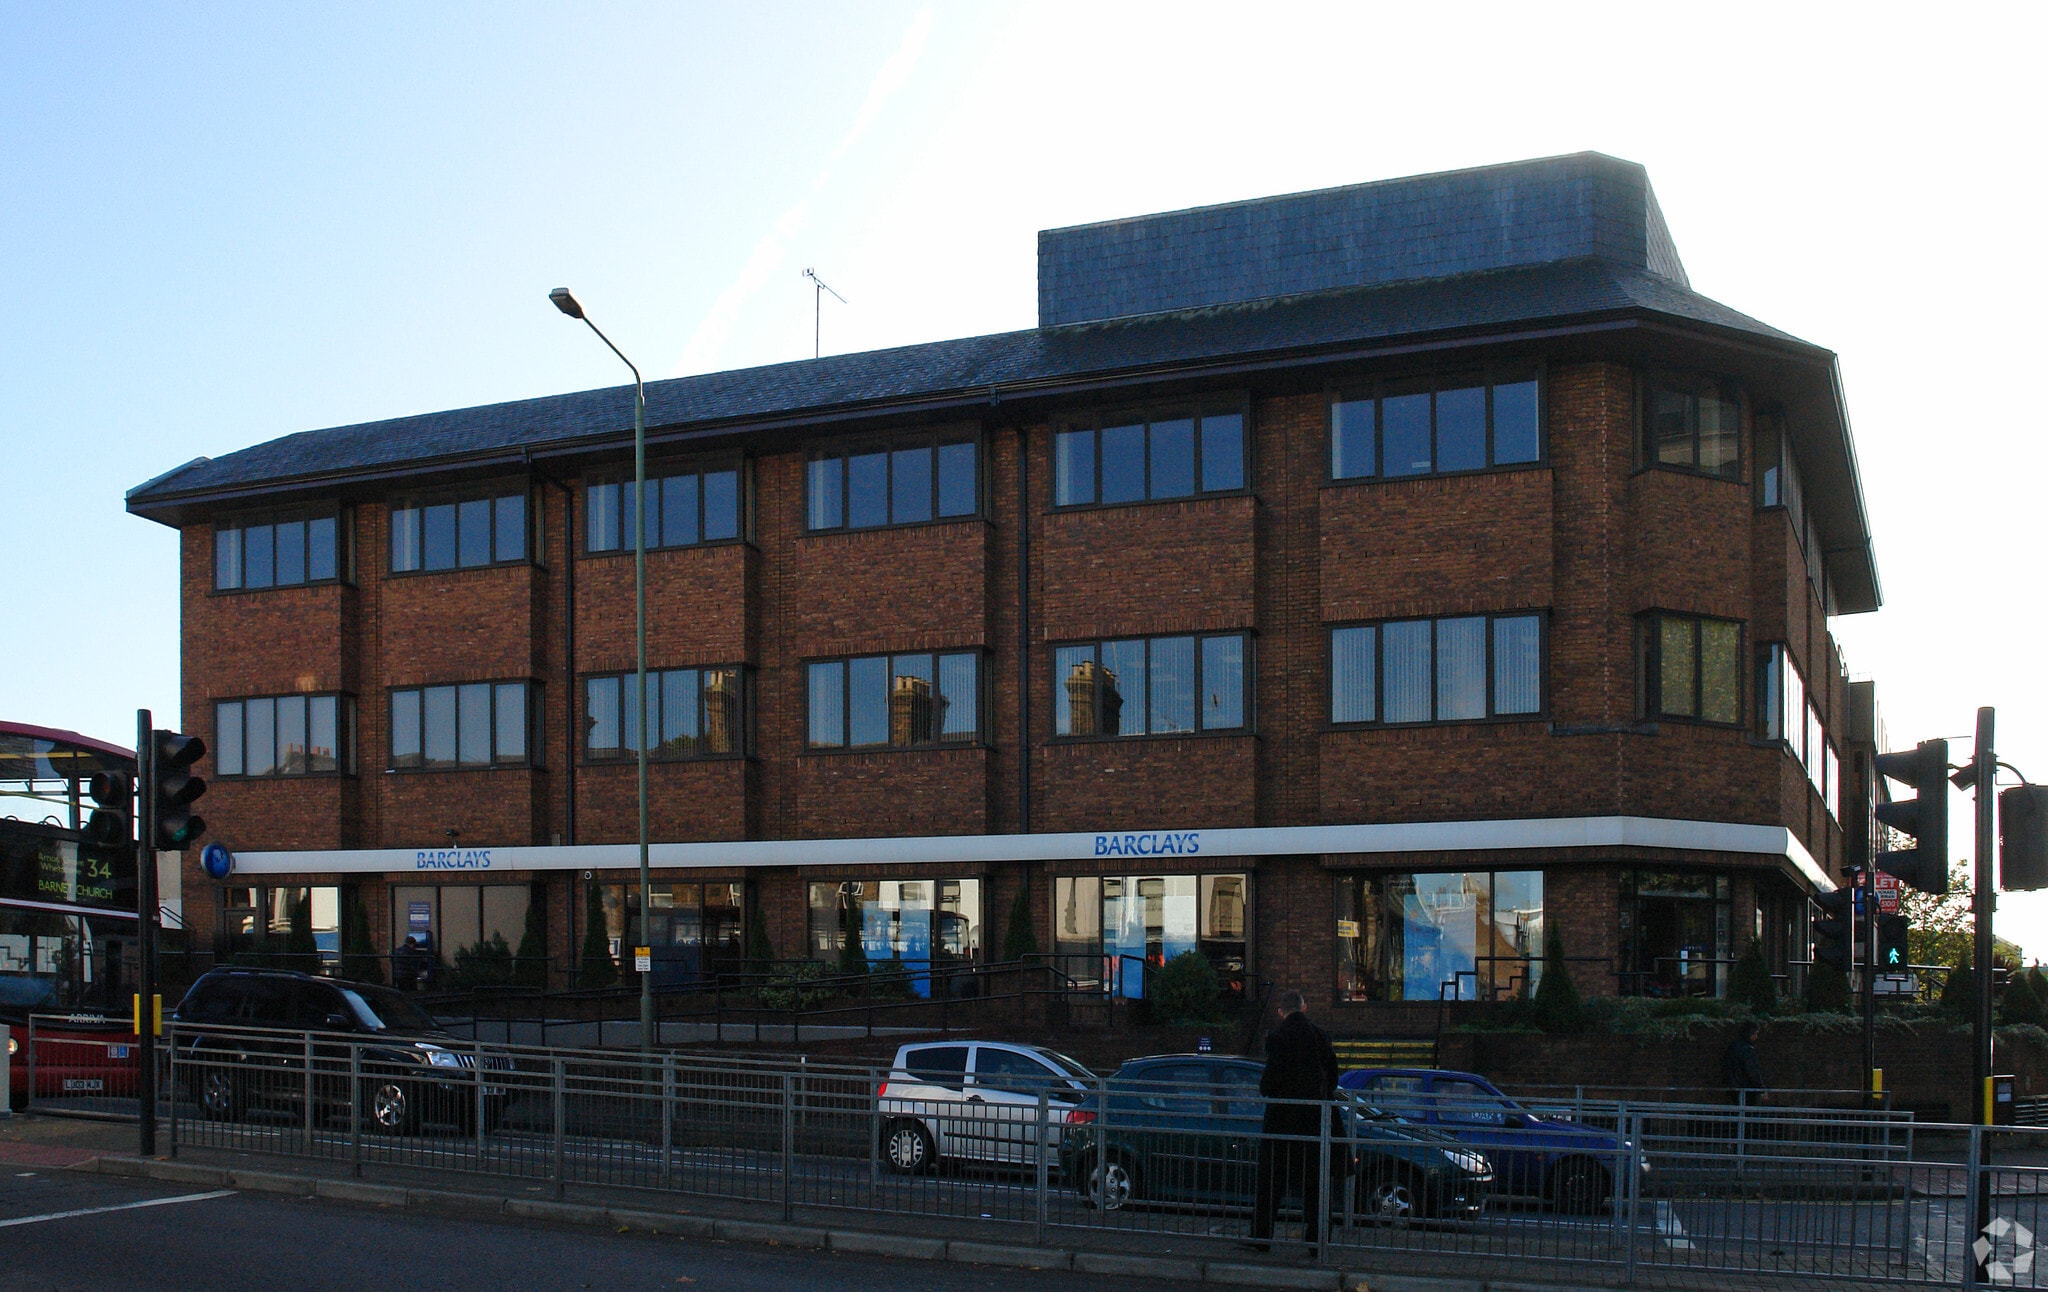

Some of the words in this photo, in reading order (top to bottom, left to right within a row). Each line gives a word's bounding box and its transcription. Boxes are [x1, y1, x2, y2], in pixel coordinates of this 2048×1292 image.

[1095, 833, 1200, 855] BARCLAYS
[86, 858, 112, 879] 34
[417, 850, 491, 869] BARCLAYS
[38, 879, 73, 894] BARNET
[76, 884, 113, 900] CHURCH
[68, 1013, 106, 1024] ARRIVA
